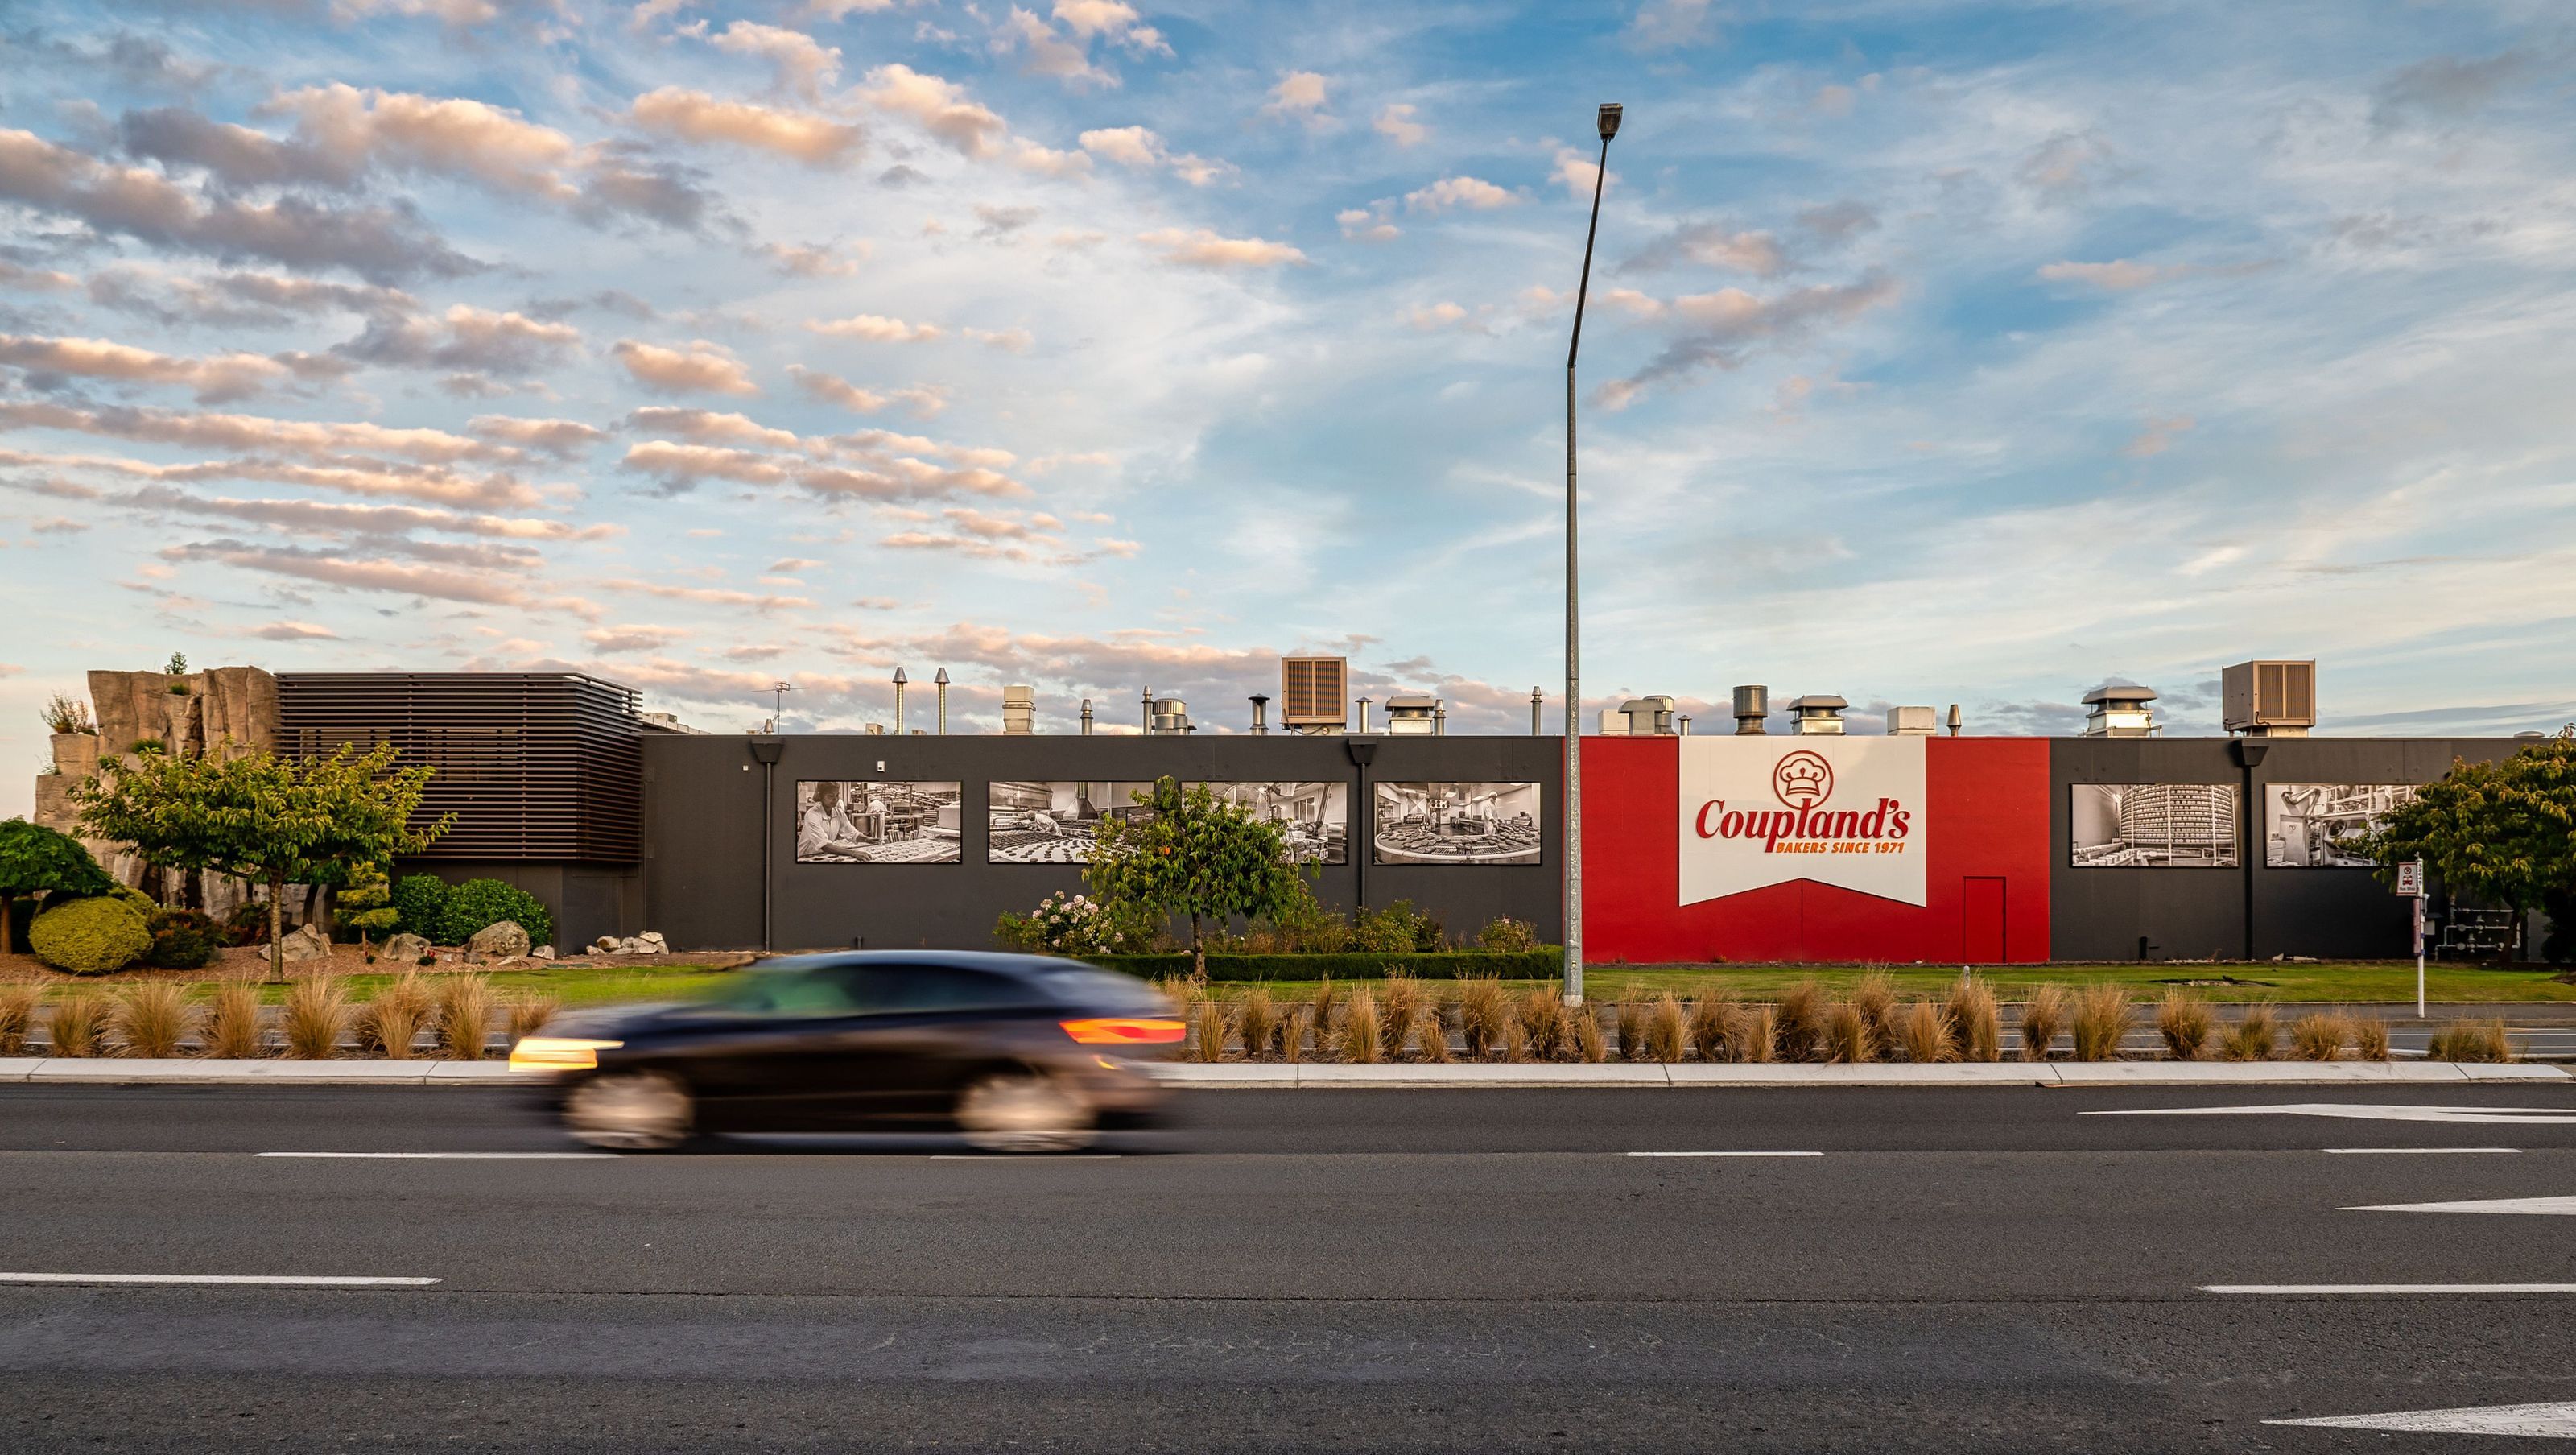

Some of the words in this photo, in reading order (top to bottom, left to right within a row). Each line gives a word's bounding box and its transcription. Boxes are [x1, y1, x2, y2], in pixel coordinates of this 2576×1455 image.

[1695, 797, 1911, 854] Coupland's
[1776, 841, 1827, 854] BAKERS
[1831, 841, 1871, 854] SINCE
[1874, 841, 1905, 854] 1971
